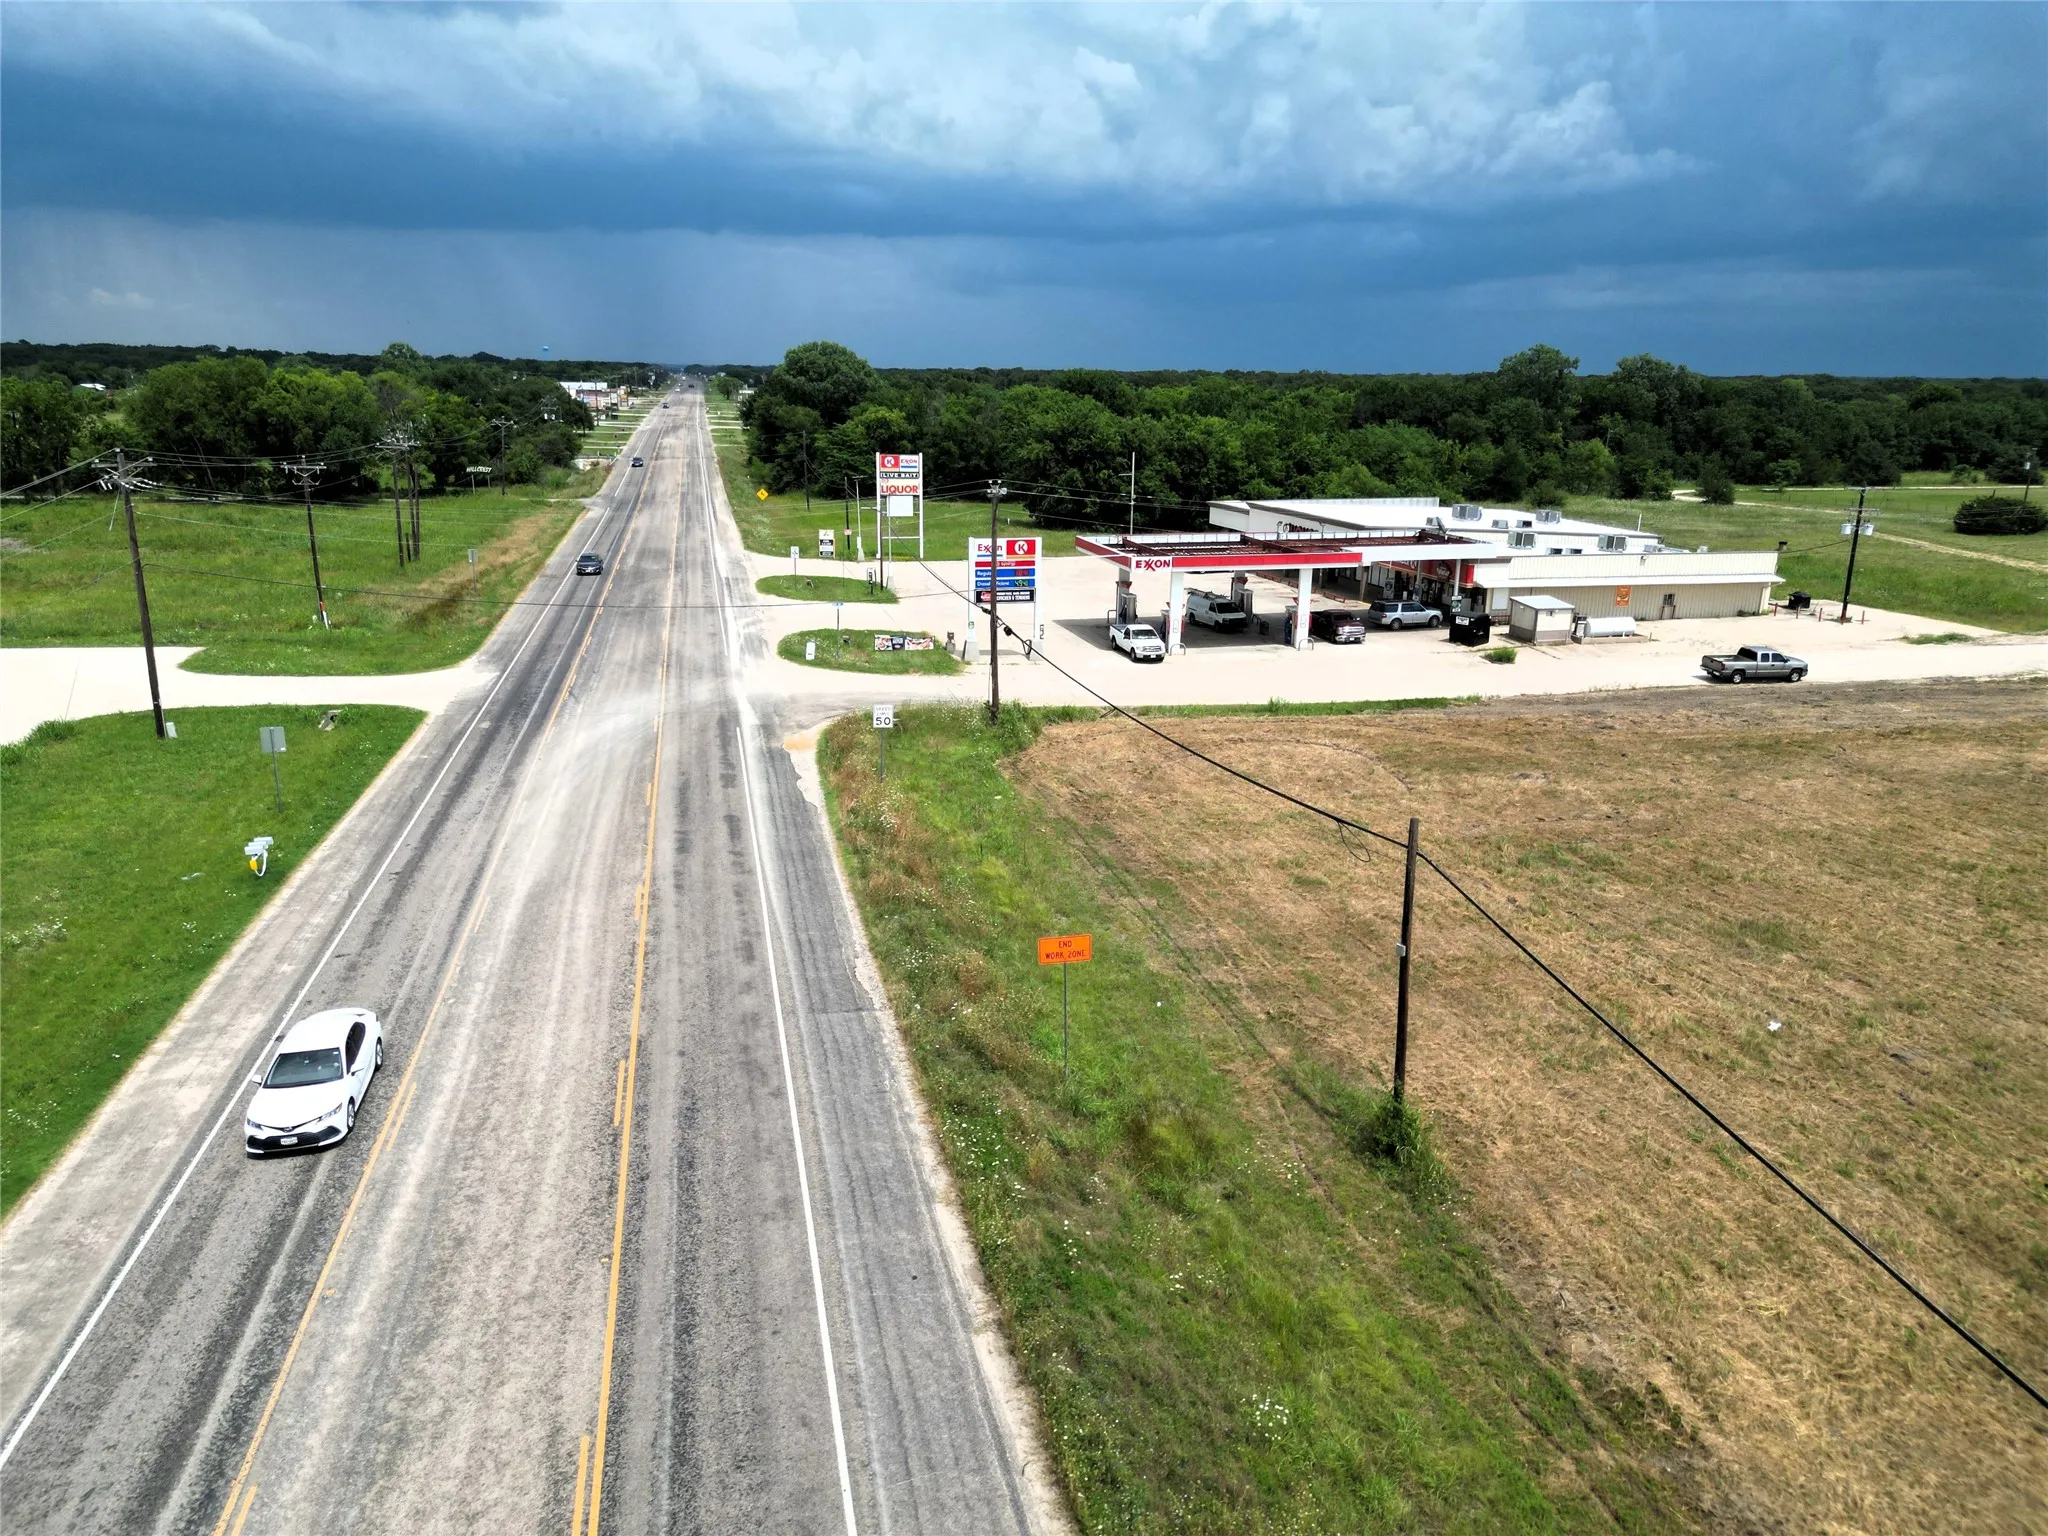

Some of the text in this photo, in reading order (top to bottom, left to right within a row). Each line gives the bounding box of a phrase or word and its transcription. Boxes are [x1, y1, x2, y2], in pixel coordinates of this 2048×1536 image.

[881, 485, 918, 495] LIQUOR
[977, 543, 1003, 553] Exxn
[1135, 558, 1171, 571] EXXON
[876, 716, 891, 726] 50
[1045, 950, 1086, 959] WORK ZONE
